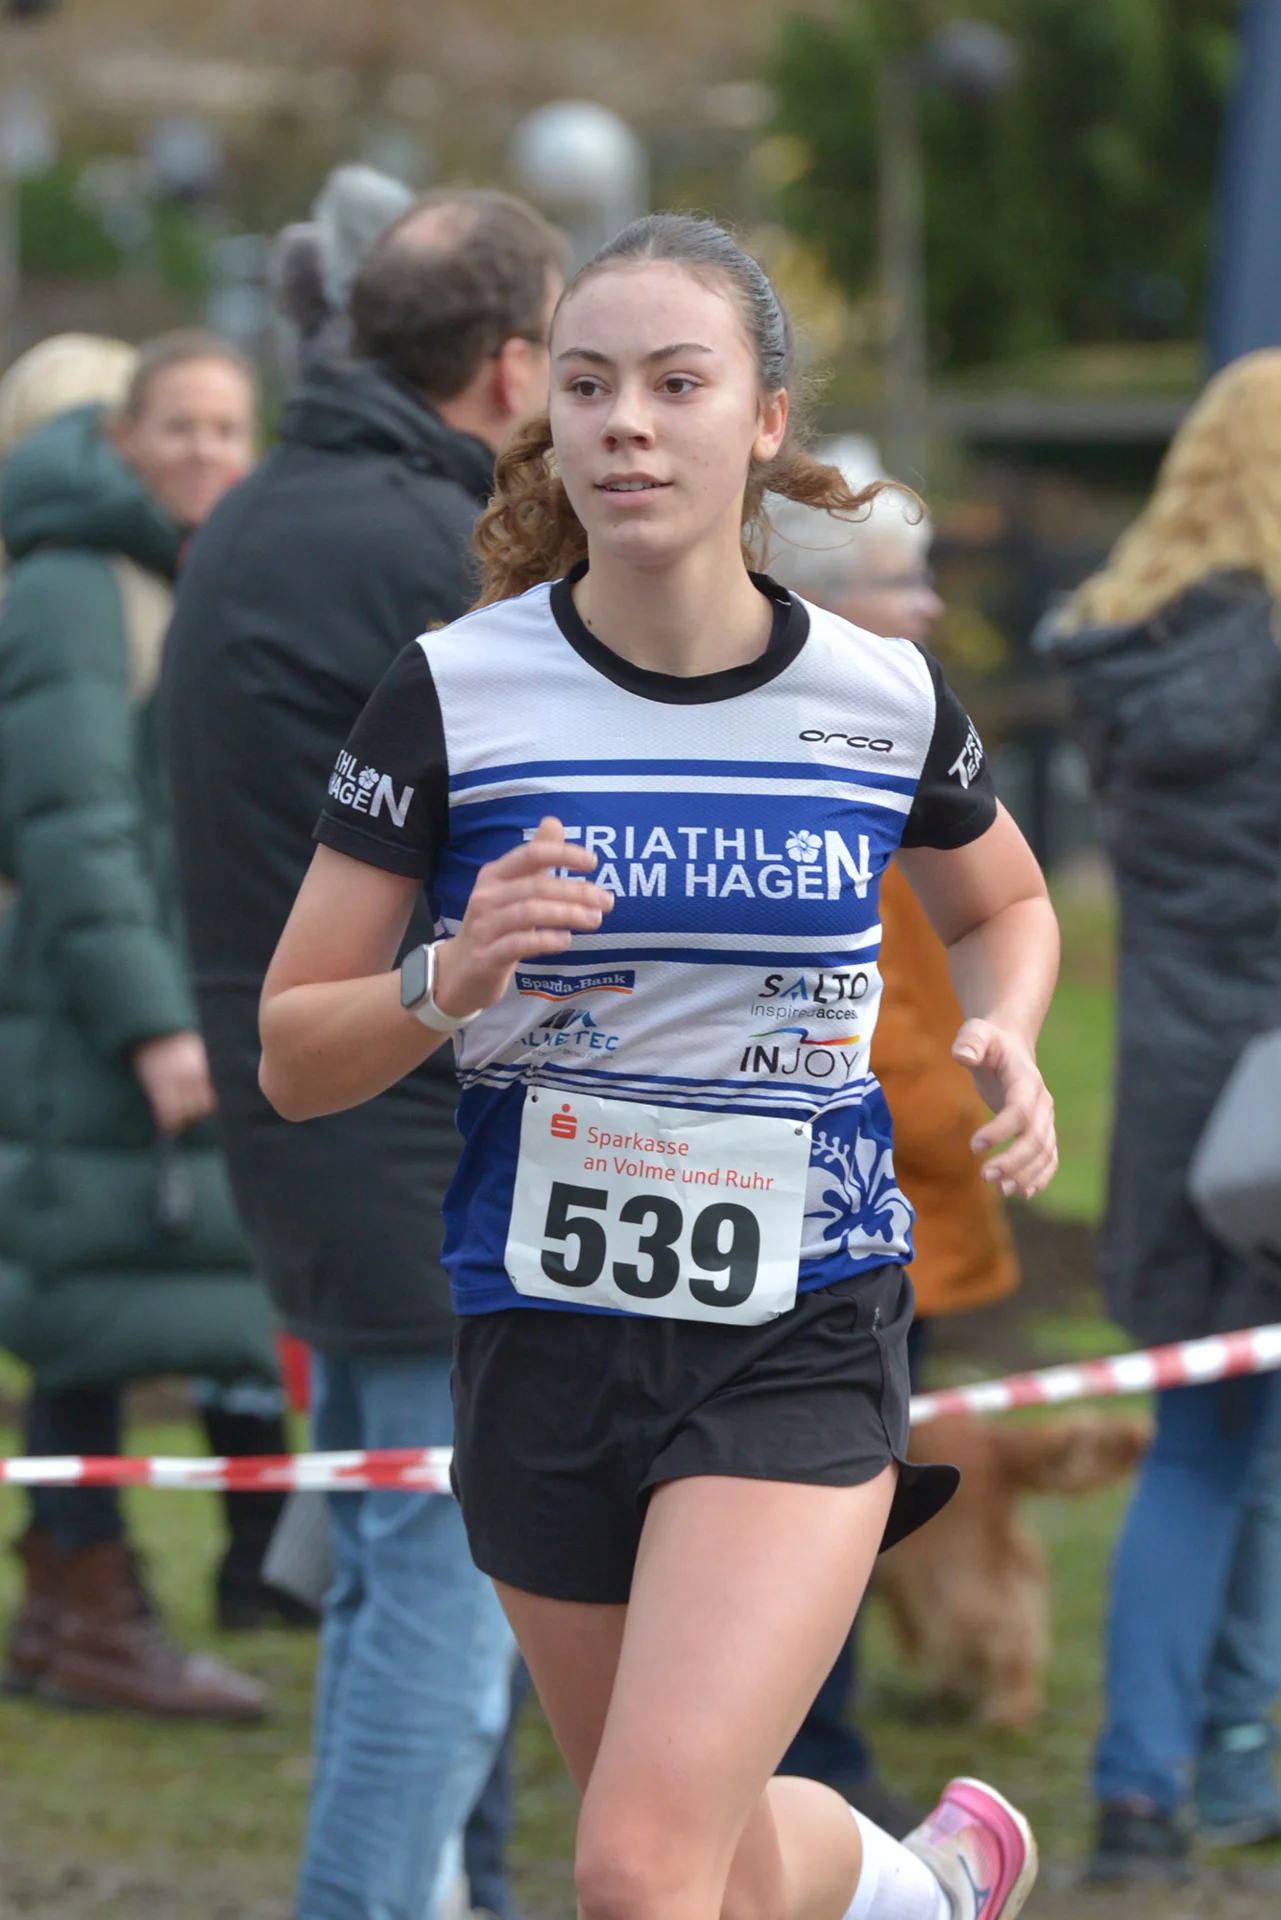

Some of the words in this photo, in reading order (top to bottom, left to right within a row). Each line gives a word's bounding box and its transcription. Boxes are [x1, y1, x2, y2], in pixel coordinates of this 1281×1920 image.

[799, 729, 894, 753] orca
[520, 973, 627, 994] Sparda-Bank
[739, 1045, 859, 1079] INJOY
[587, 1127, 689, 1156] Sparkasse
[583, 1156, 607, 1173] an
[613, 1157, 676, 1182] Volme
[682, 1169, 719, 1186] und
[725, 1169, 774, 1190] Ruhr
[540, 1181, 761, 1308] 539
